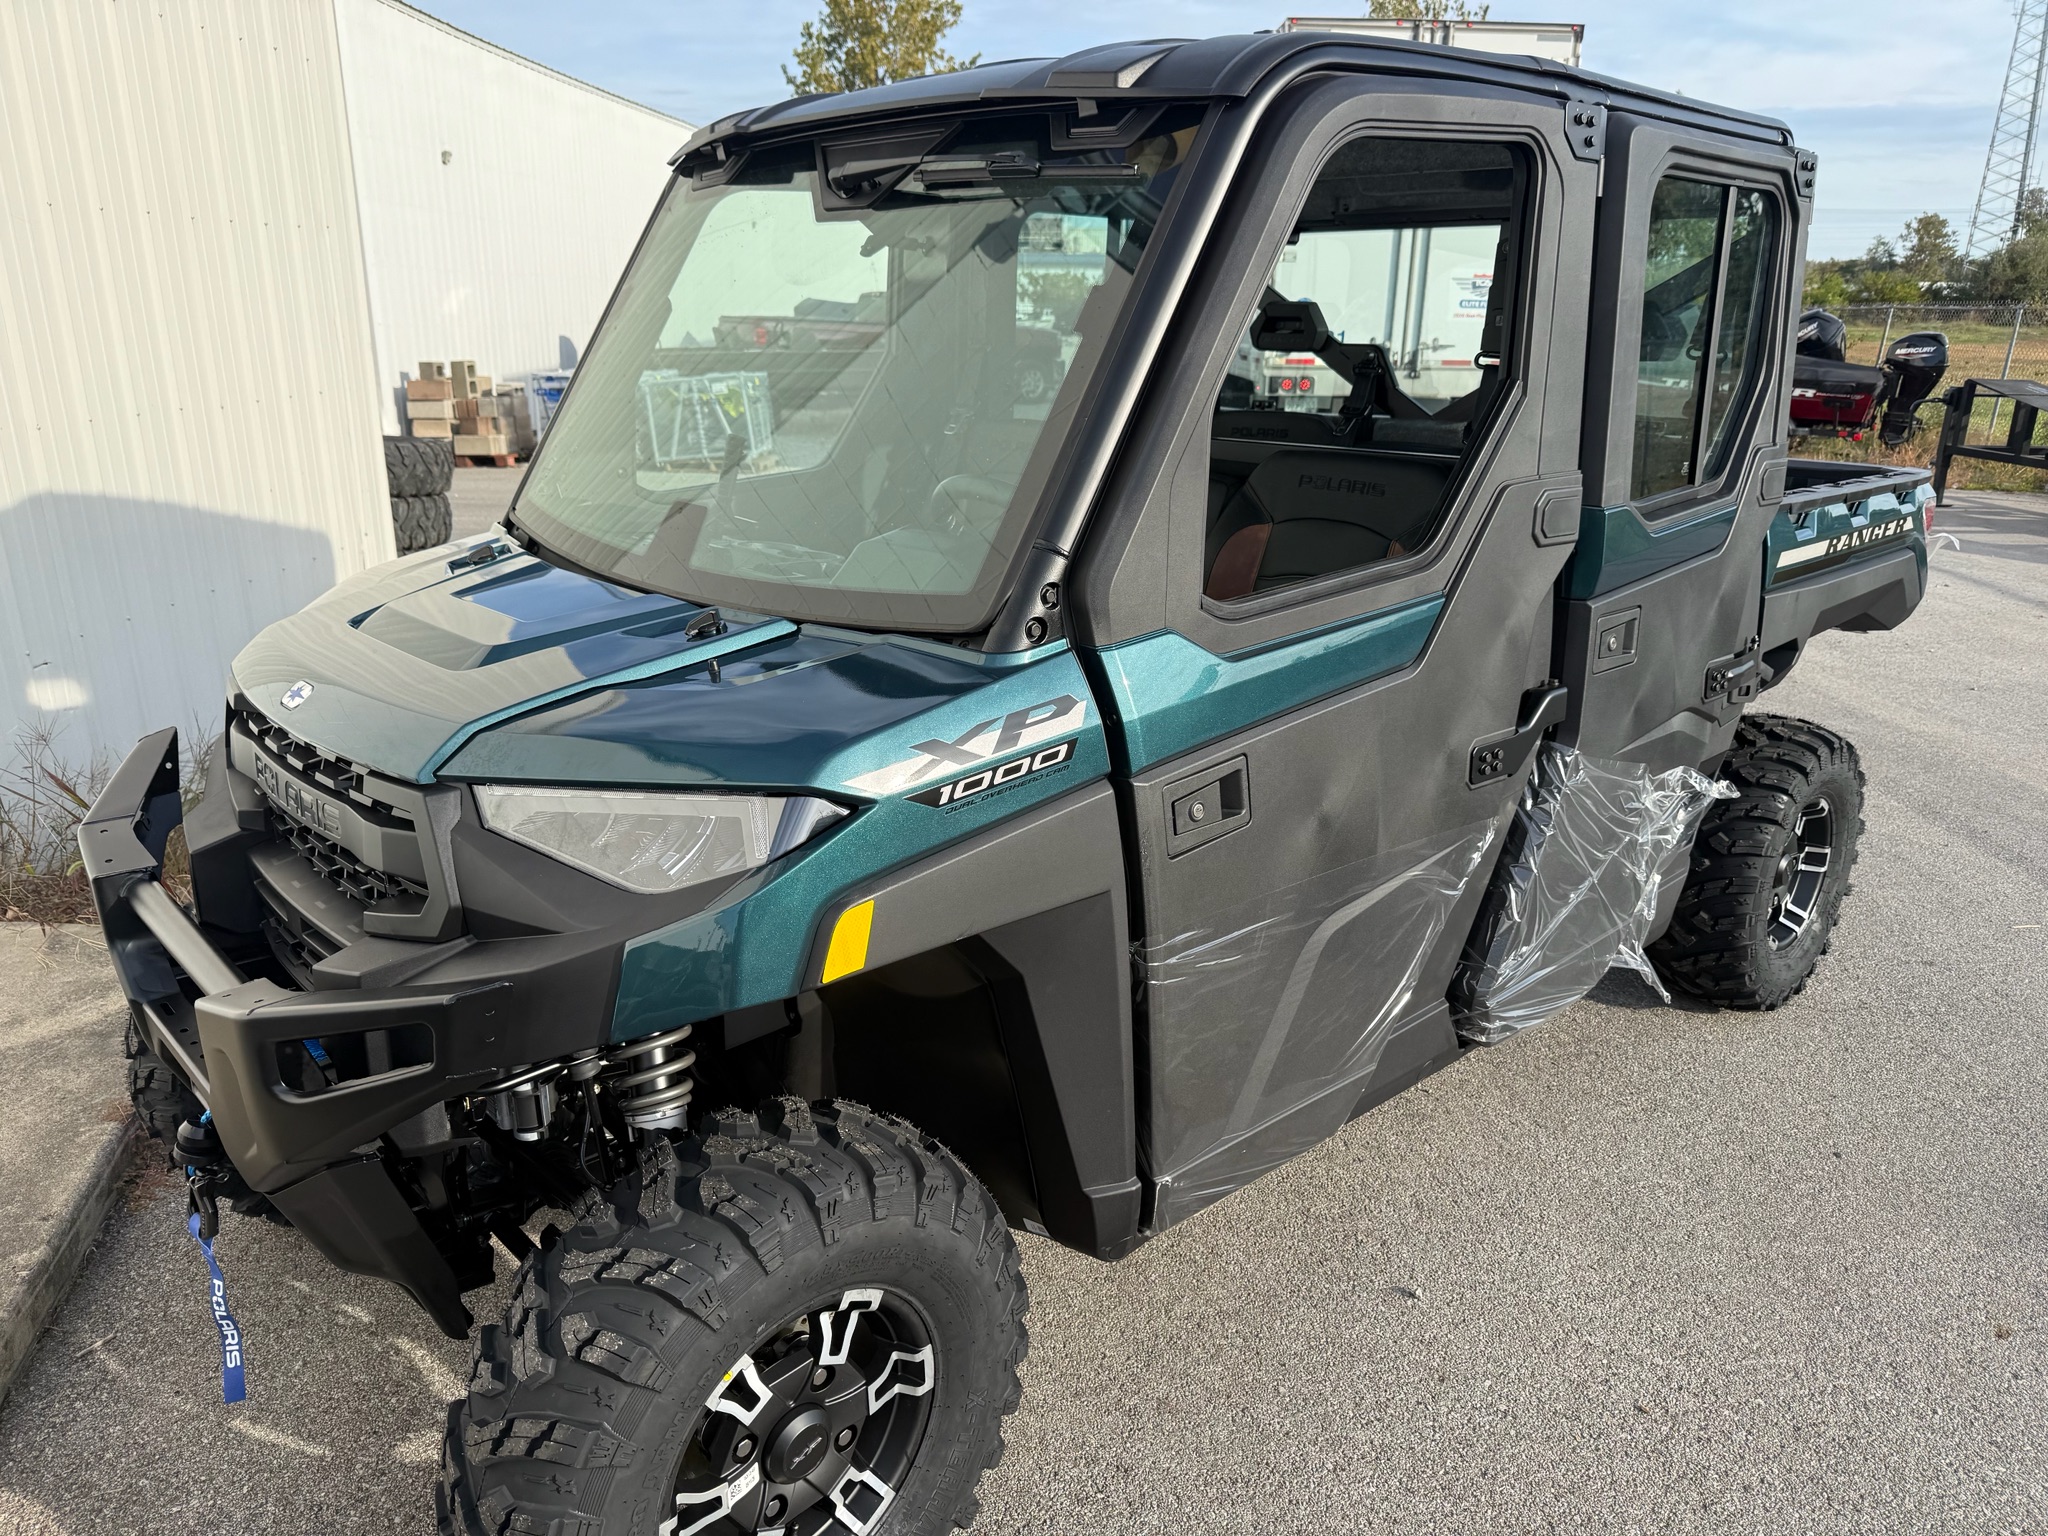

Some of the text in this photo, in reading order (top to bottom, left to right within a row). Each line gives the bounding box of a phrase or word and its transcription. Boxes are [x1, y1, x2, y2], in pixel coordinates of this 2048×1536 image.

[1895, 345, 1938, 356] MERCURY
[1230, 426, 1290, 439] POLARIS
[1298, 473, 1387, 498] POLARIS
[1825, 517, 1909, 556] RANGER
[905, 693, 1081, 779] XP
[254, 752, 343, 839] POLARIS
[938, 742, 1069, 806] 1000
[944, 764, 1070, 815] DUAL OVERHEAD CAM
[212, 1279, 242, 1369] POLARIS
